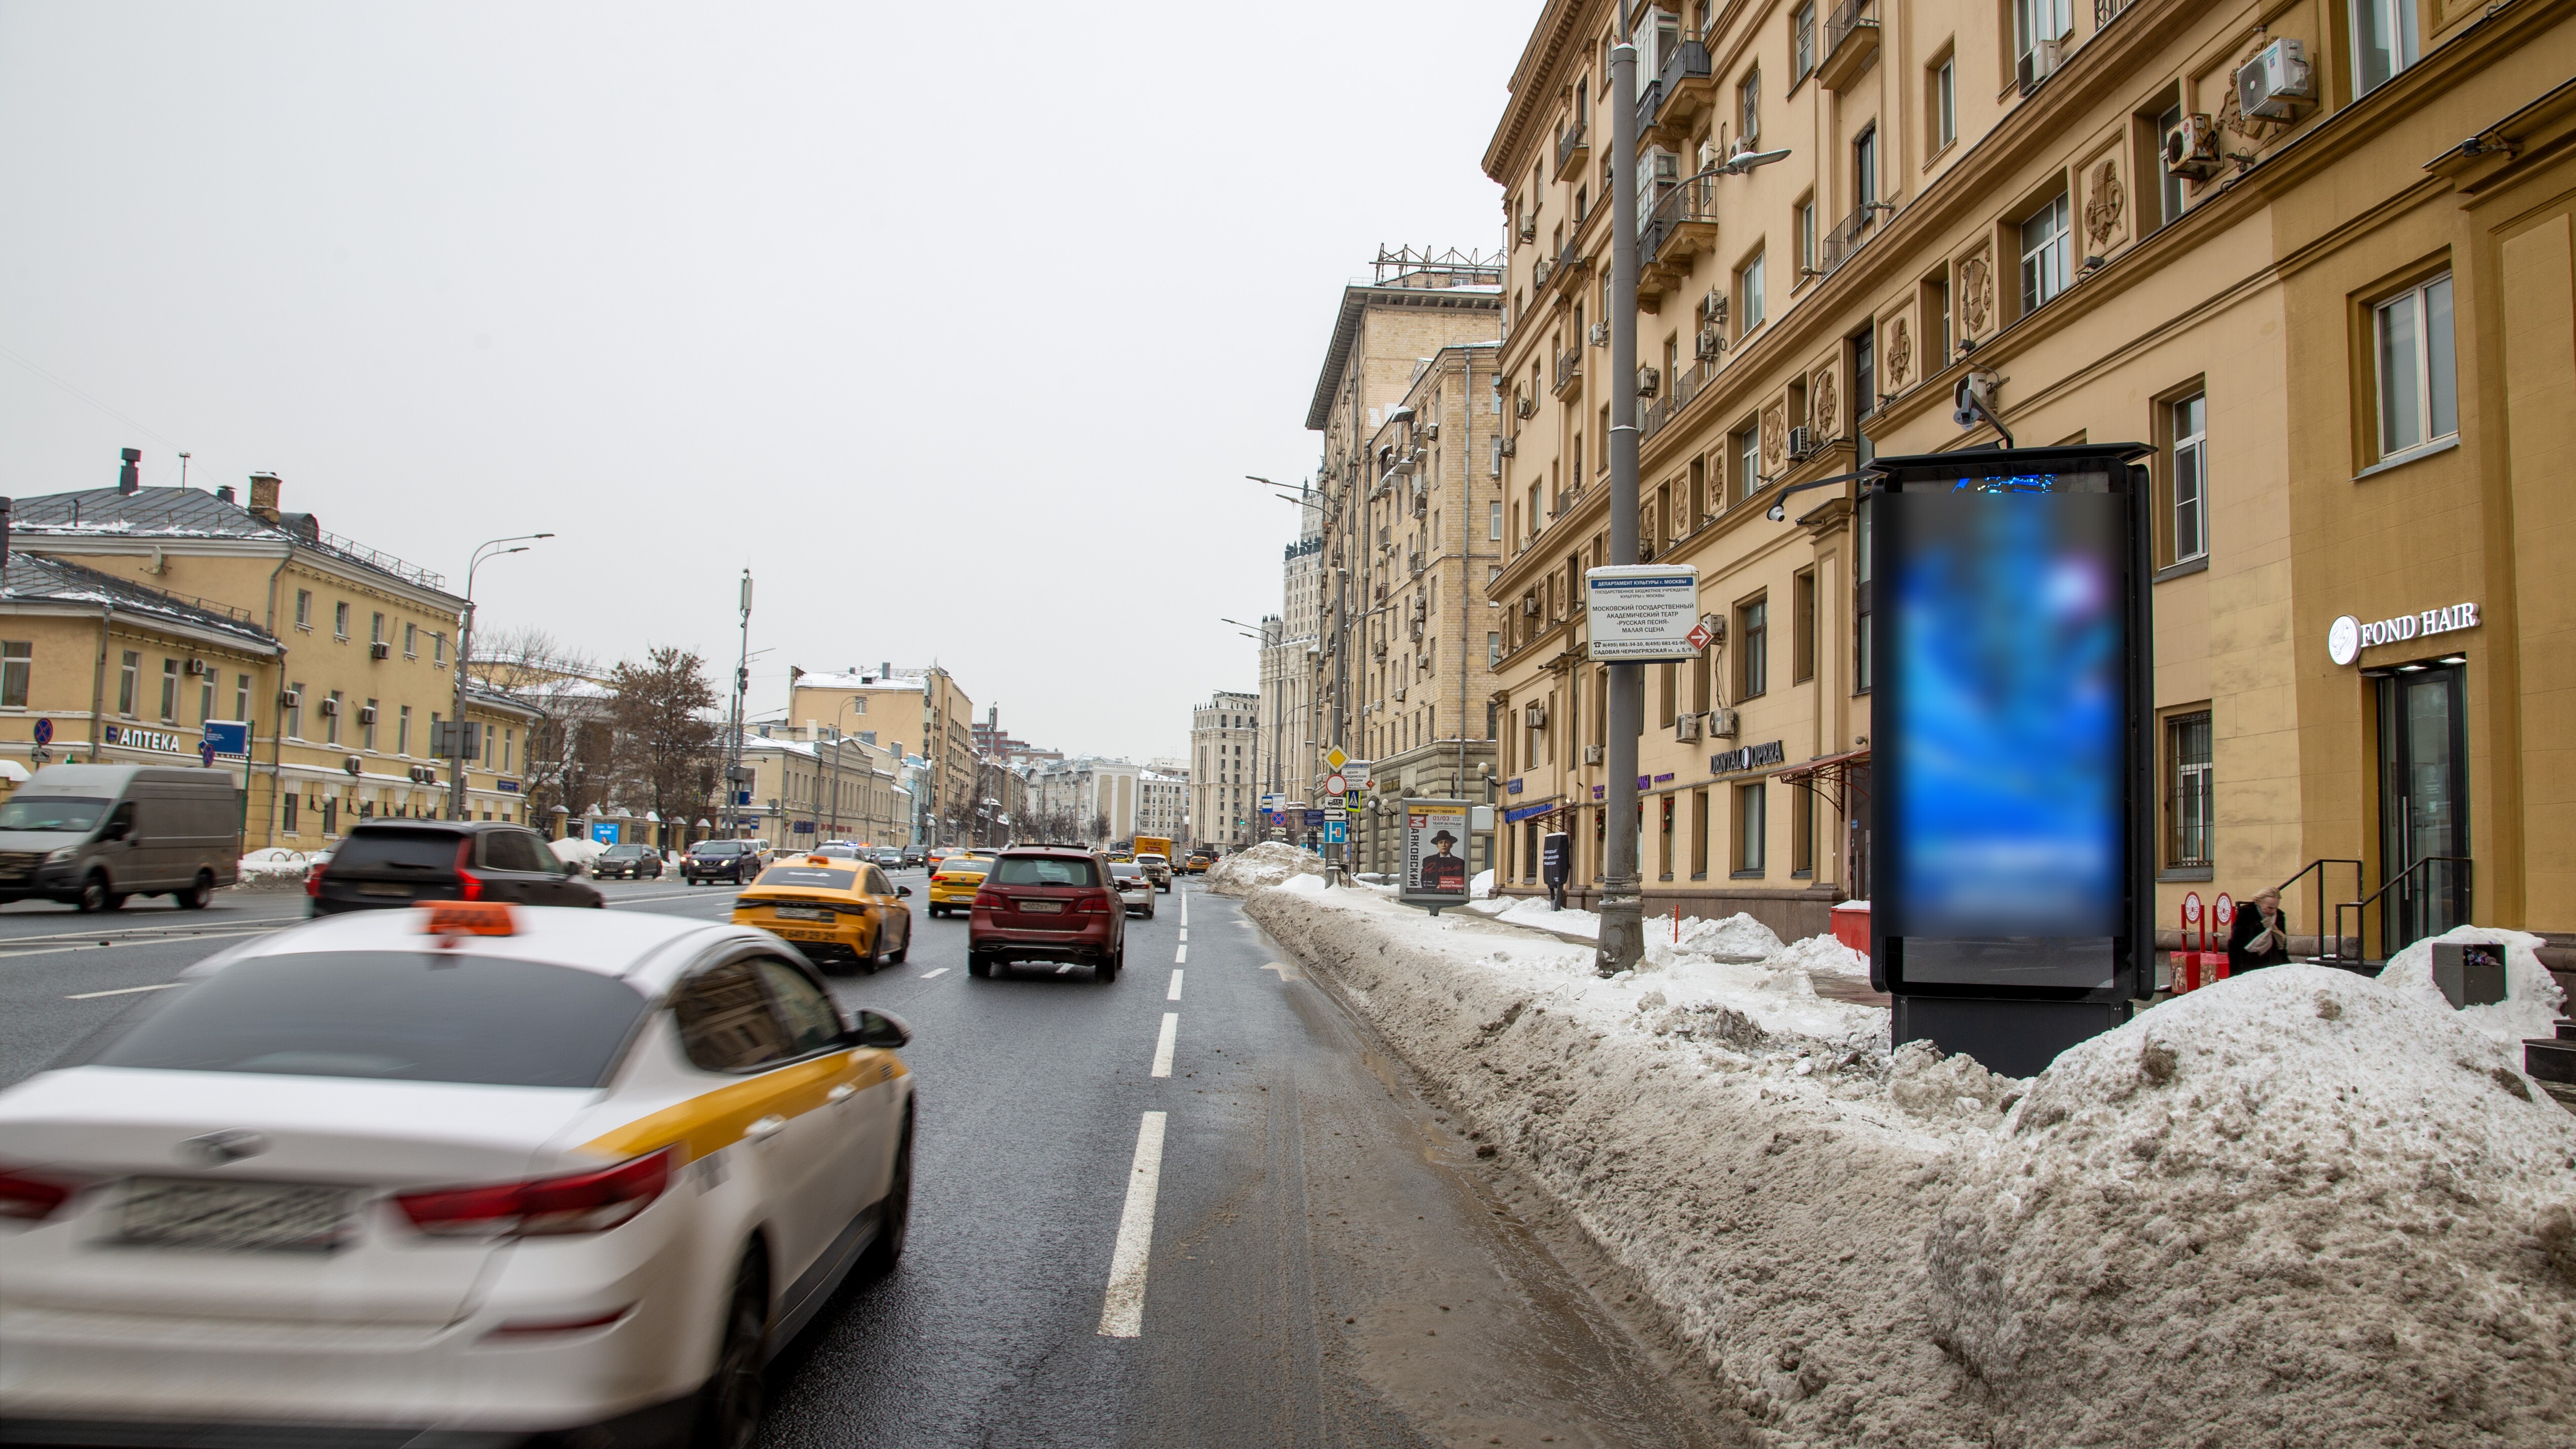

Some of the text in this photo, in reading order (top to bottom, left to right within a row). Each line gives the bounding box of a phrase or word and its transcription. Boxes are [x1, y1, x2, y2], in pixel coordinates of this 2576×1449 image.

[1606, 611, 1659, 619] АКАДЕМИЧЕСКИЙ
[1636, 602, 1694, 611] ГОСУДАРСТВЕННЫЙ
[2360, 602, 2476, 648] FOND HAIR
[119, 728, 179, 752] АПТЕКА
[1709, 741, 1781, 775] DENTAL OPERA
[1410, 816, 1424, 887] МАЯКОВСКИЙ
